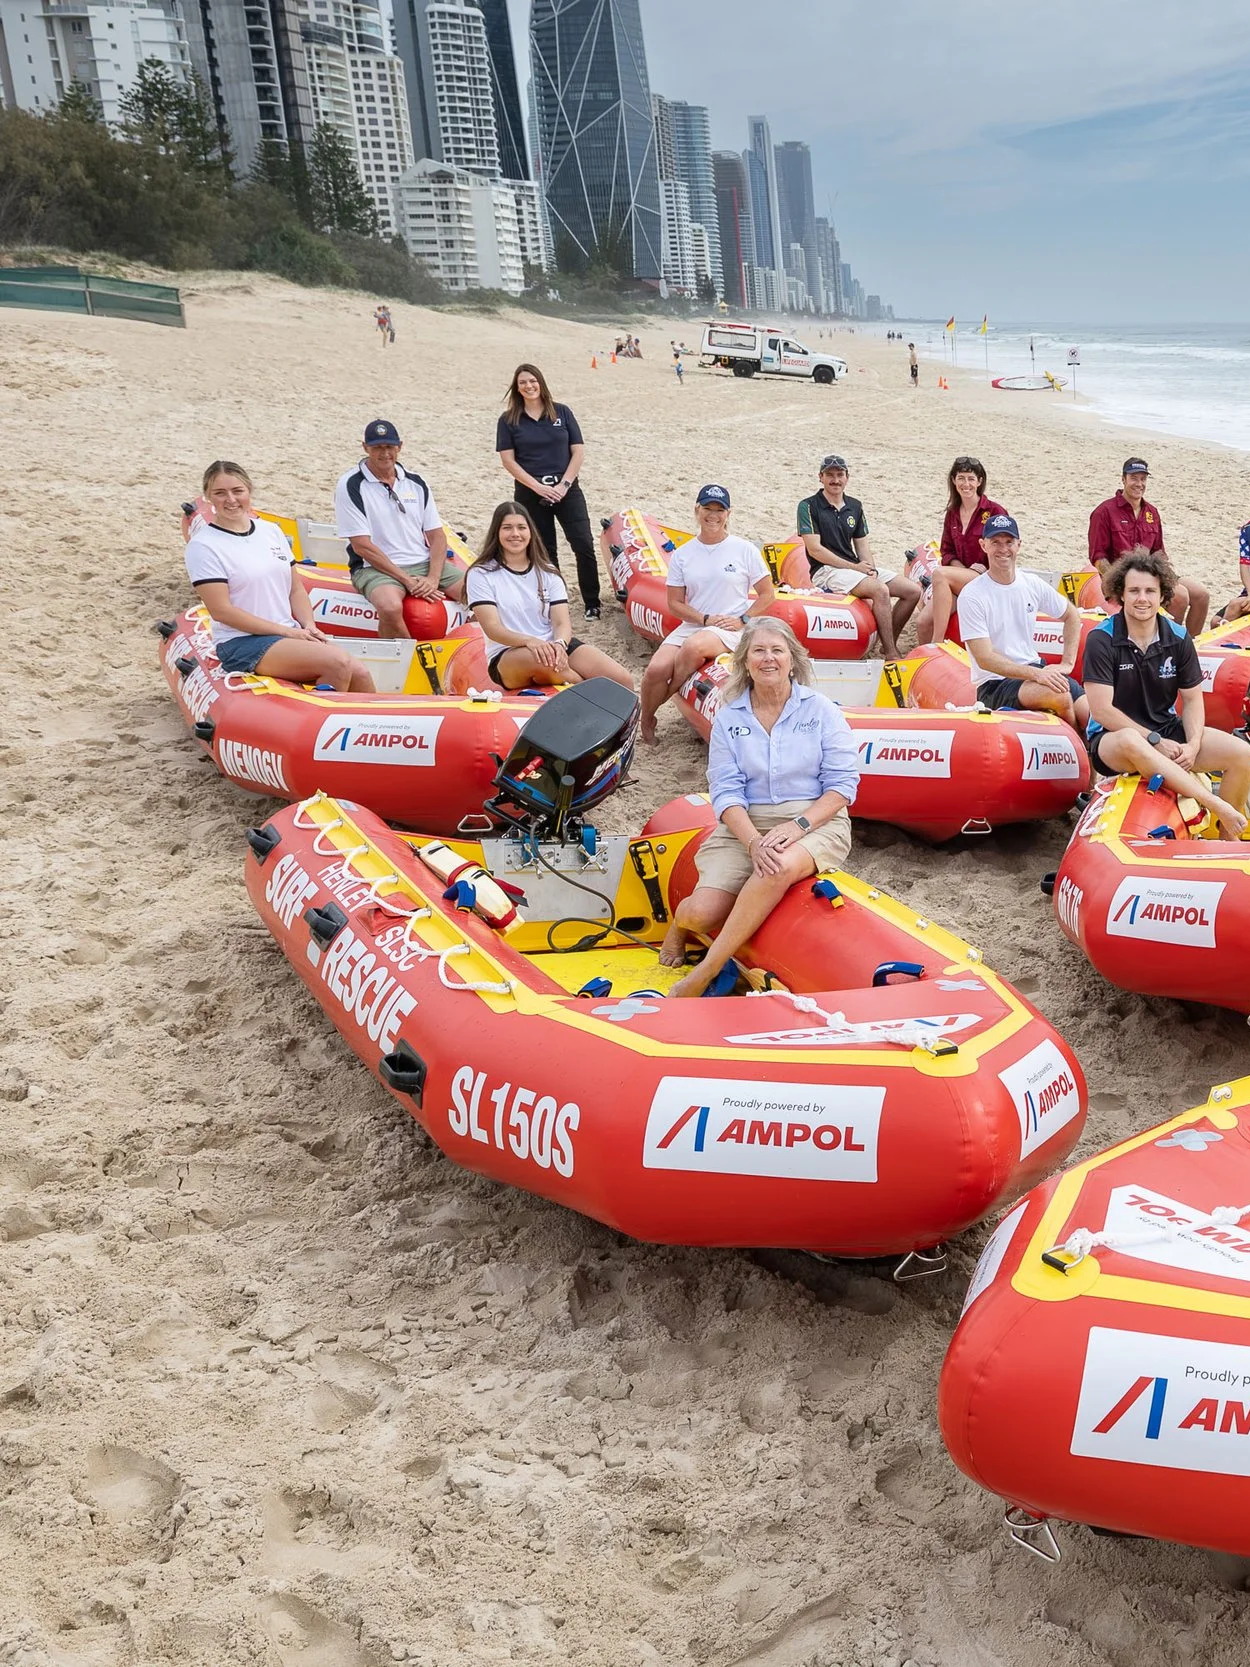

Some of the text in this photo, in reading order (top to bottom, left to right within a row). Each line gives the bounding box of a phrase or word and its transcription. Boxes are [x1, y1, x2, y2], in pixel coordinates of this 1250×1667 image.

[823, 620, 855, 630] AMPOL
[353, 733, 429, 749] AMPOL
[876, 748, 944, 763] AMPOL
[1041, 752, 1076, 765] AMPOL
[265, 853, 321, 931] SURF
[1140, 902, 1210, 926] AMPOL
[321, 926, 419, 1055] RESCUE
[1038, 1071, 1074, 1118] AMPOL
[722, 1097, 826, 1114] Proudly powered by
[448, 1065, 581, 1179] SL150S
[716, 1119, 865, 1152] AMPOL
[1185, 1366, 1240, 1385] Proudly
